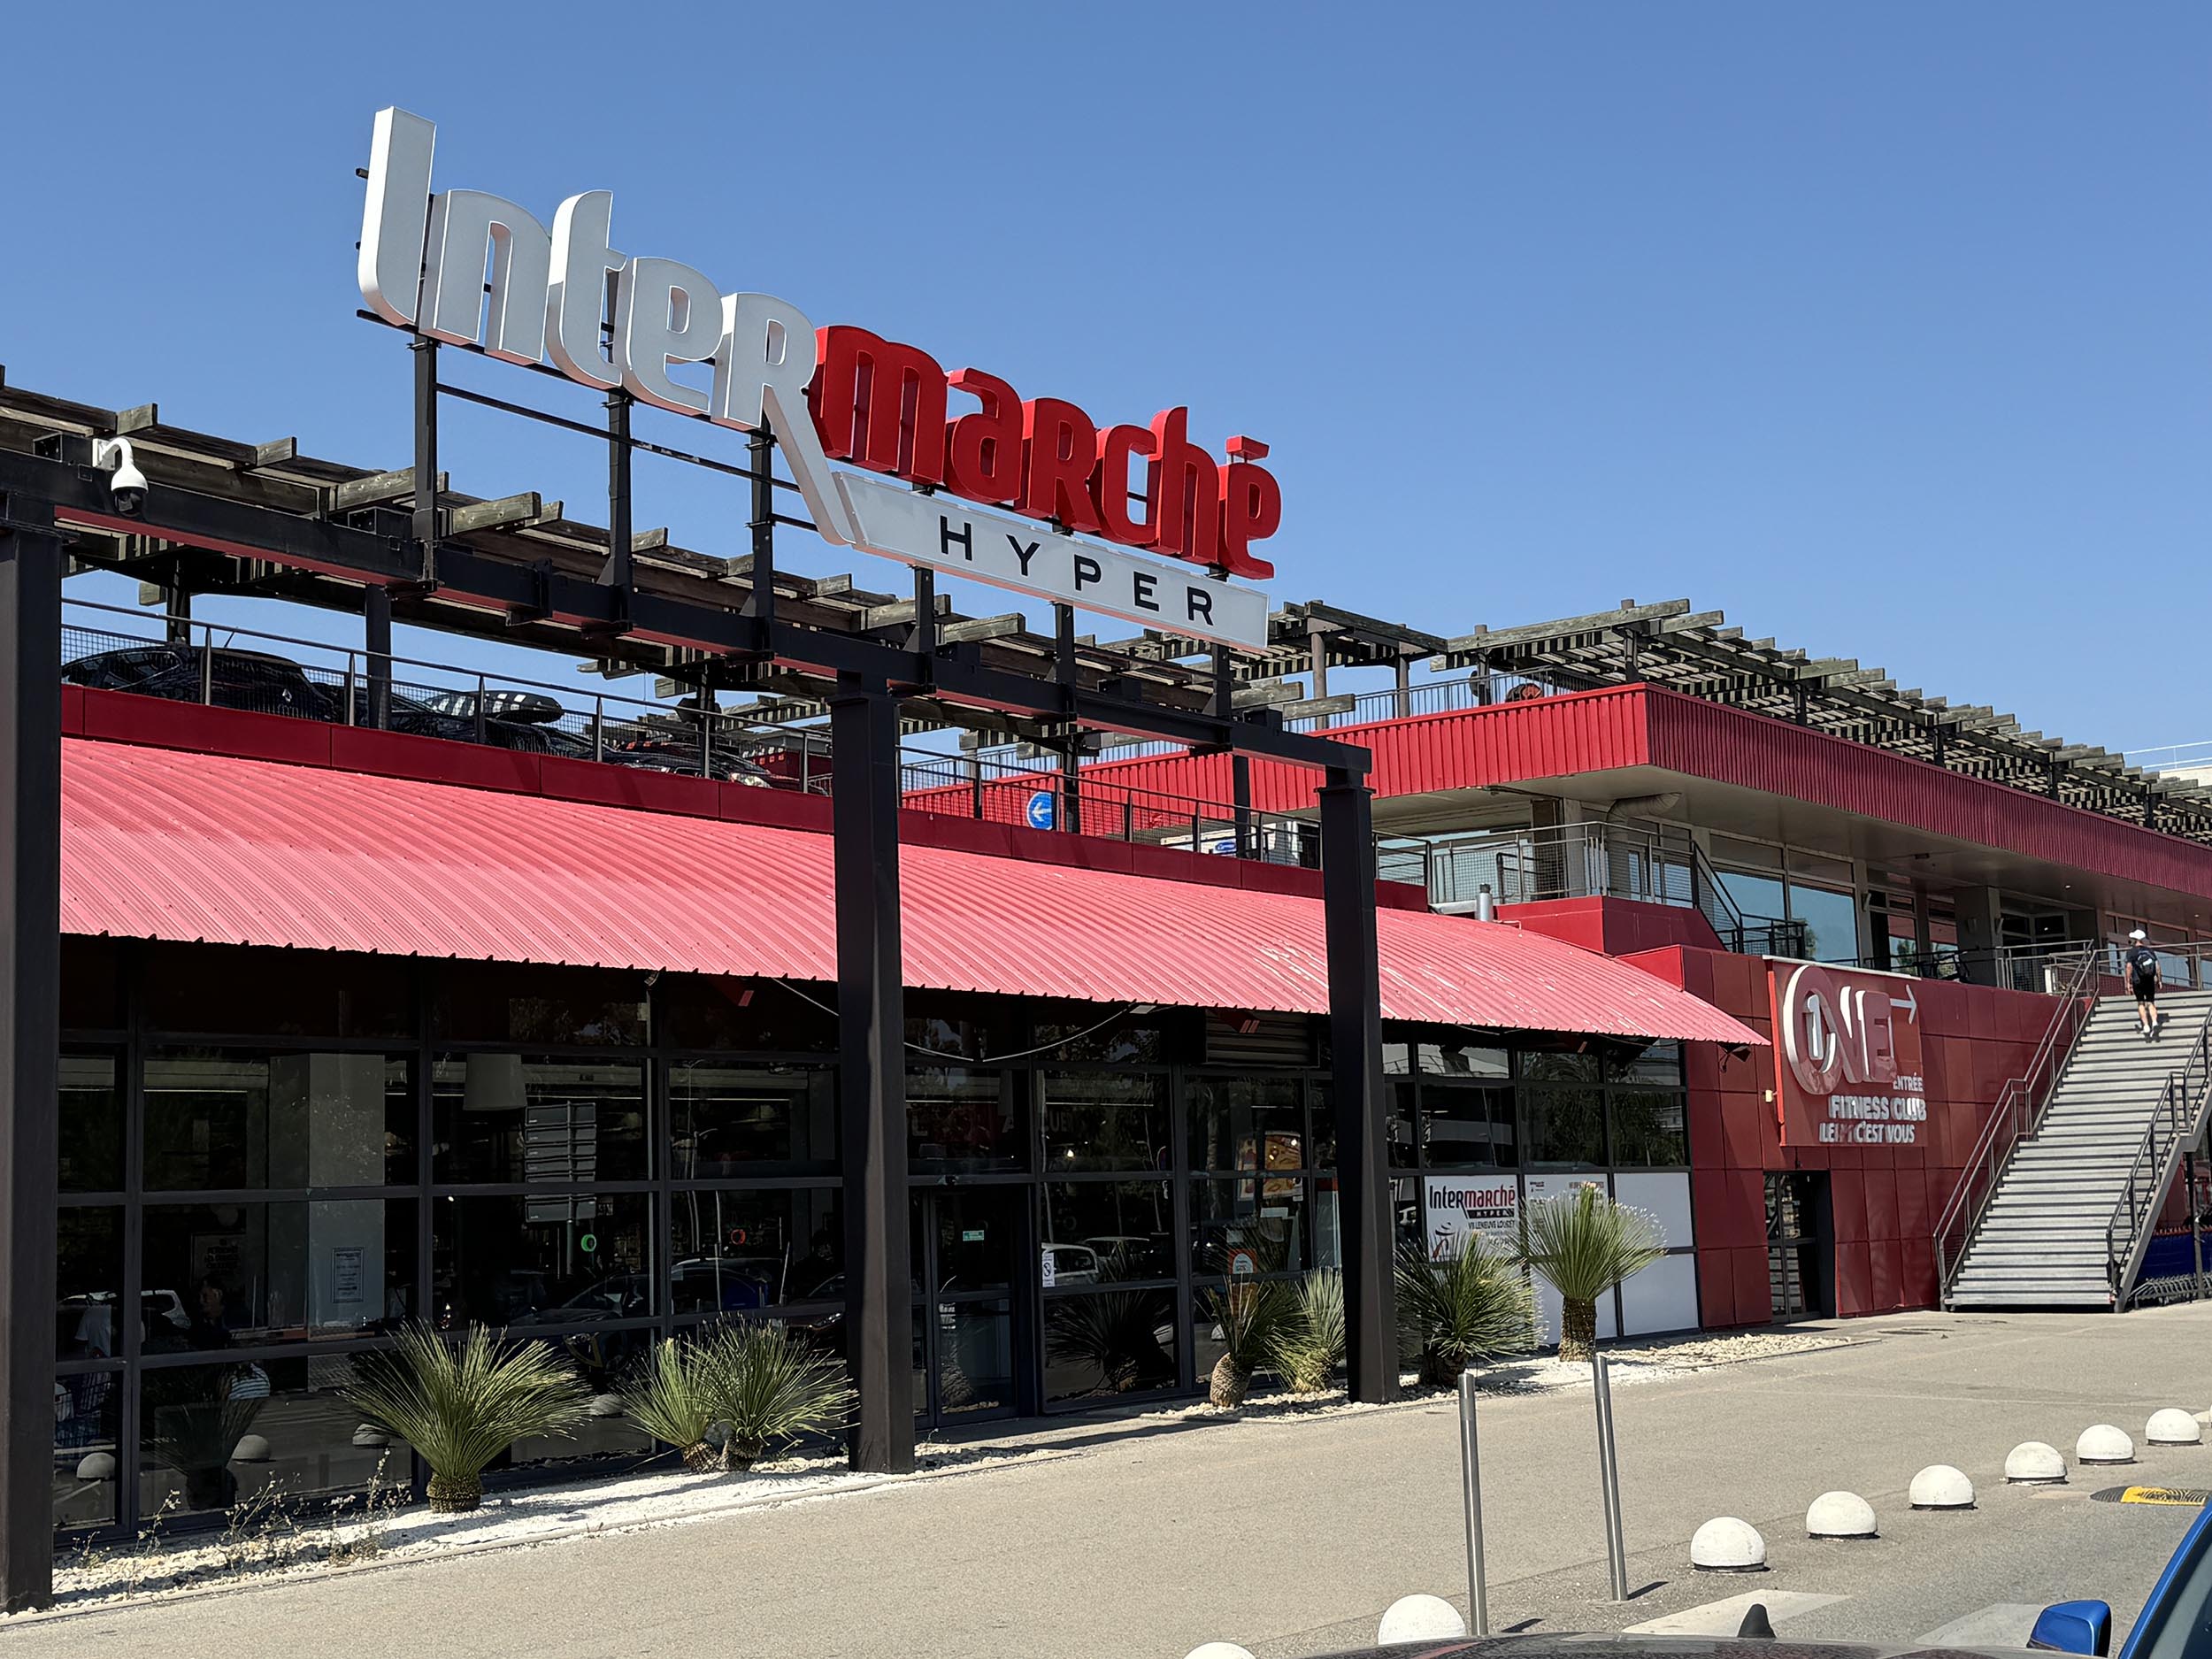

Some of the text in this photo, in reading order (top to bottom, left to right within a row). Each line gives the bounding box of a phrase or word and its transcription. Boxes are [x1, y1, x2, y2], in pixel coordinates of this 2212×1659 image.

[940, 515, 1215, 626] HYPER
[1828, 1095, 1927, 1122] FITNESS CLUB
[1885, 1125, 1915, 1144] VOUS
